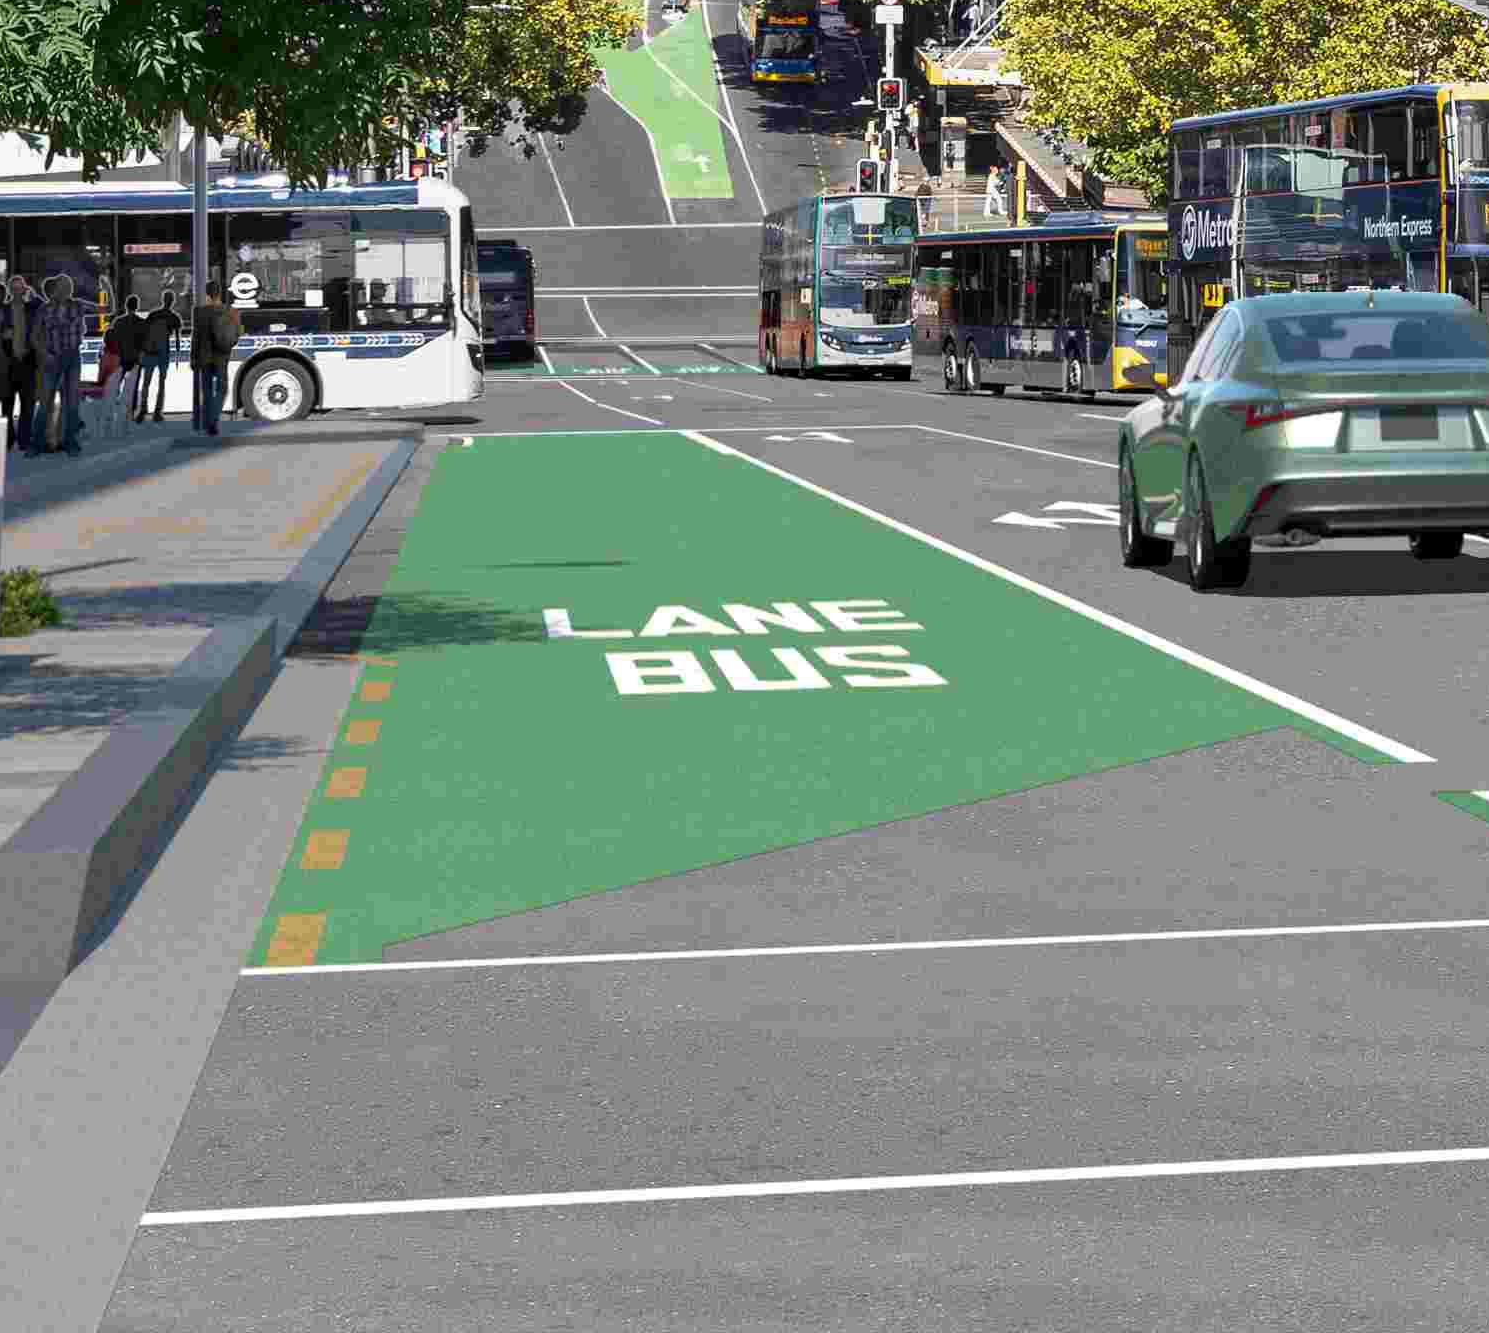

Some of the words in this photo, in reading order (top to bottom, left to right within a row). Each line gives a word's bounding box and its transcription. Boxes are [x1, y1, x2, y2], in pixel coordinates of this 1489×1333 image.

[1198, 210, 1235, 247] Metro
[1364, 214, 1398, 239] Northern
[1401, 214, 1432, 240] Express
[542, 599, 925, 639] LANE
[604, 644, 950, 696] BUS
